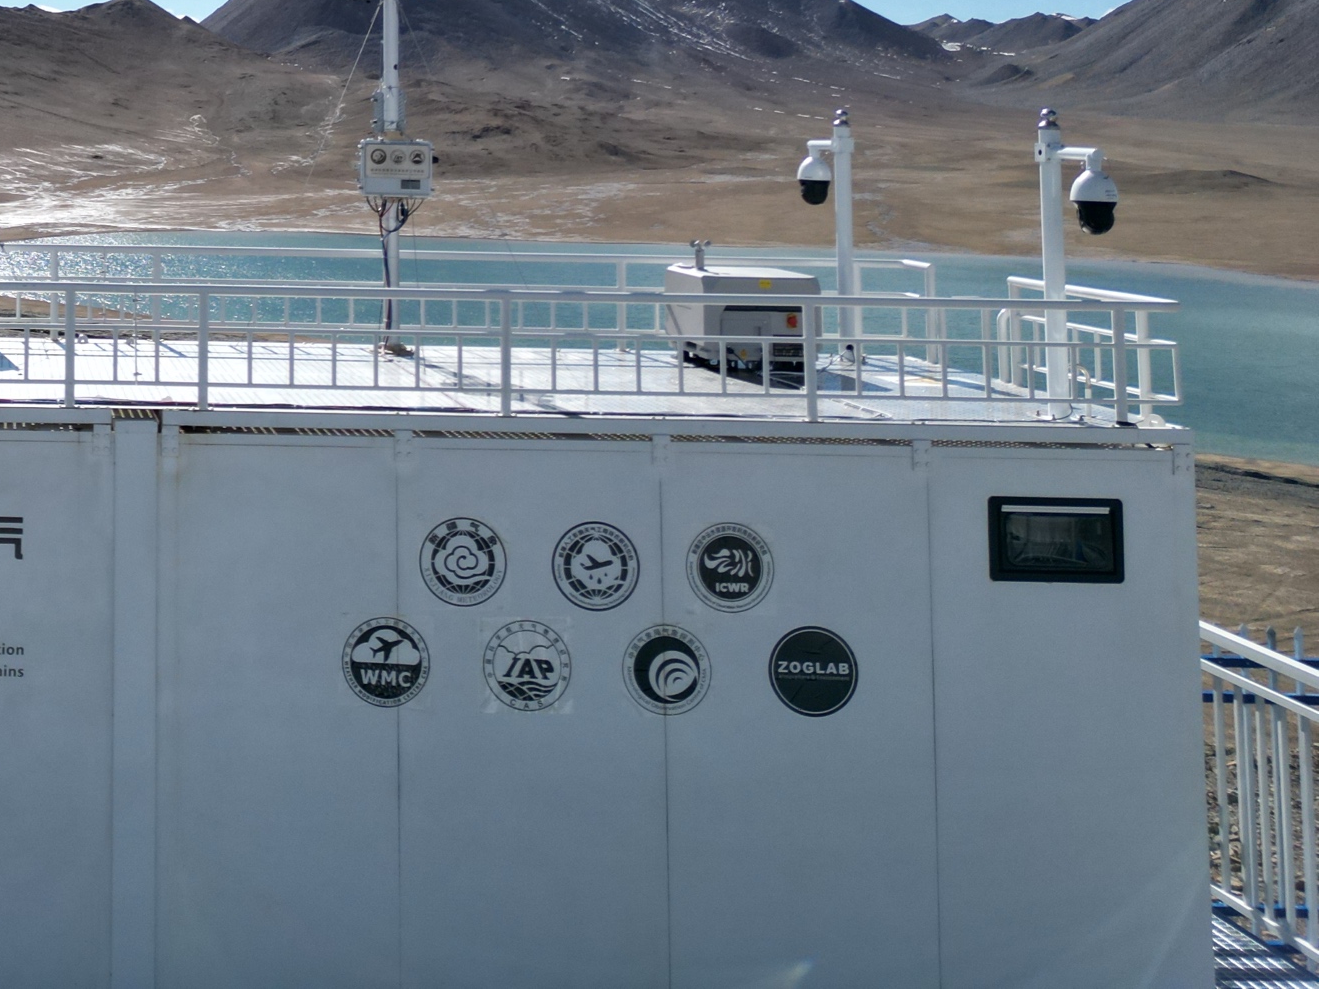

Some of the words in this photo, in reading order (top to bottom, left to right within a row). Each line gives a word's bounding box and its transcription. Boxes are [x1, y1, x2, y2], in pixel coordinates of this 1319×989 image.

[715, 582, 750, 593] ICWR
[344, 661, 359, 689] WEATHER
[502, 657, 555, 681] IAP
[778, 661, 850, 675] ZOGLAB
[360, 669, 412, 687] WMC
[510, 699, 544, 710] CAS
